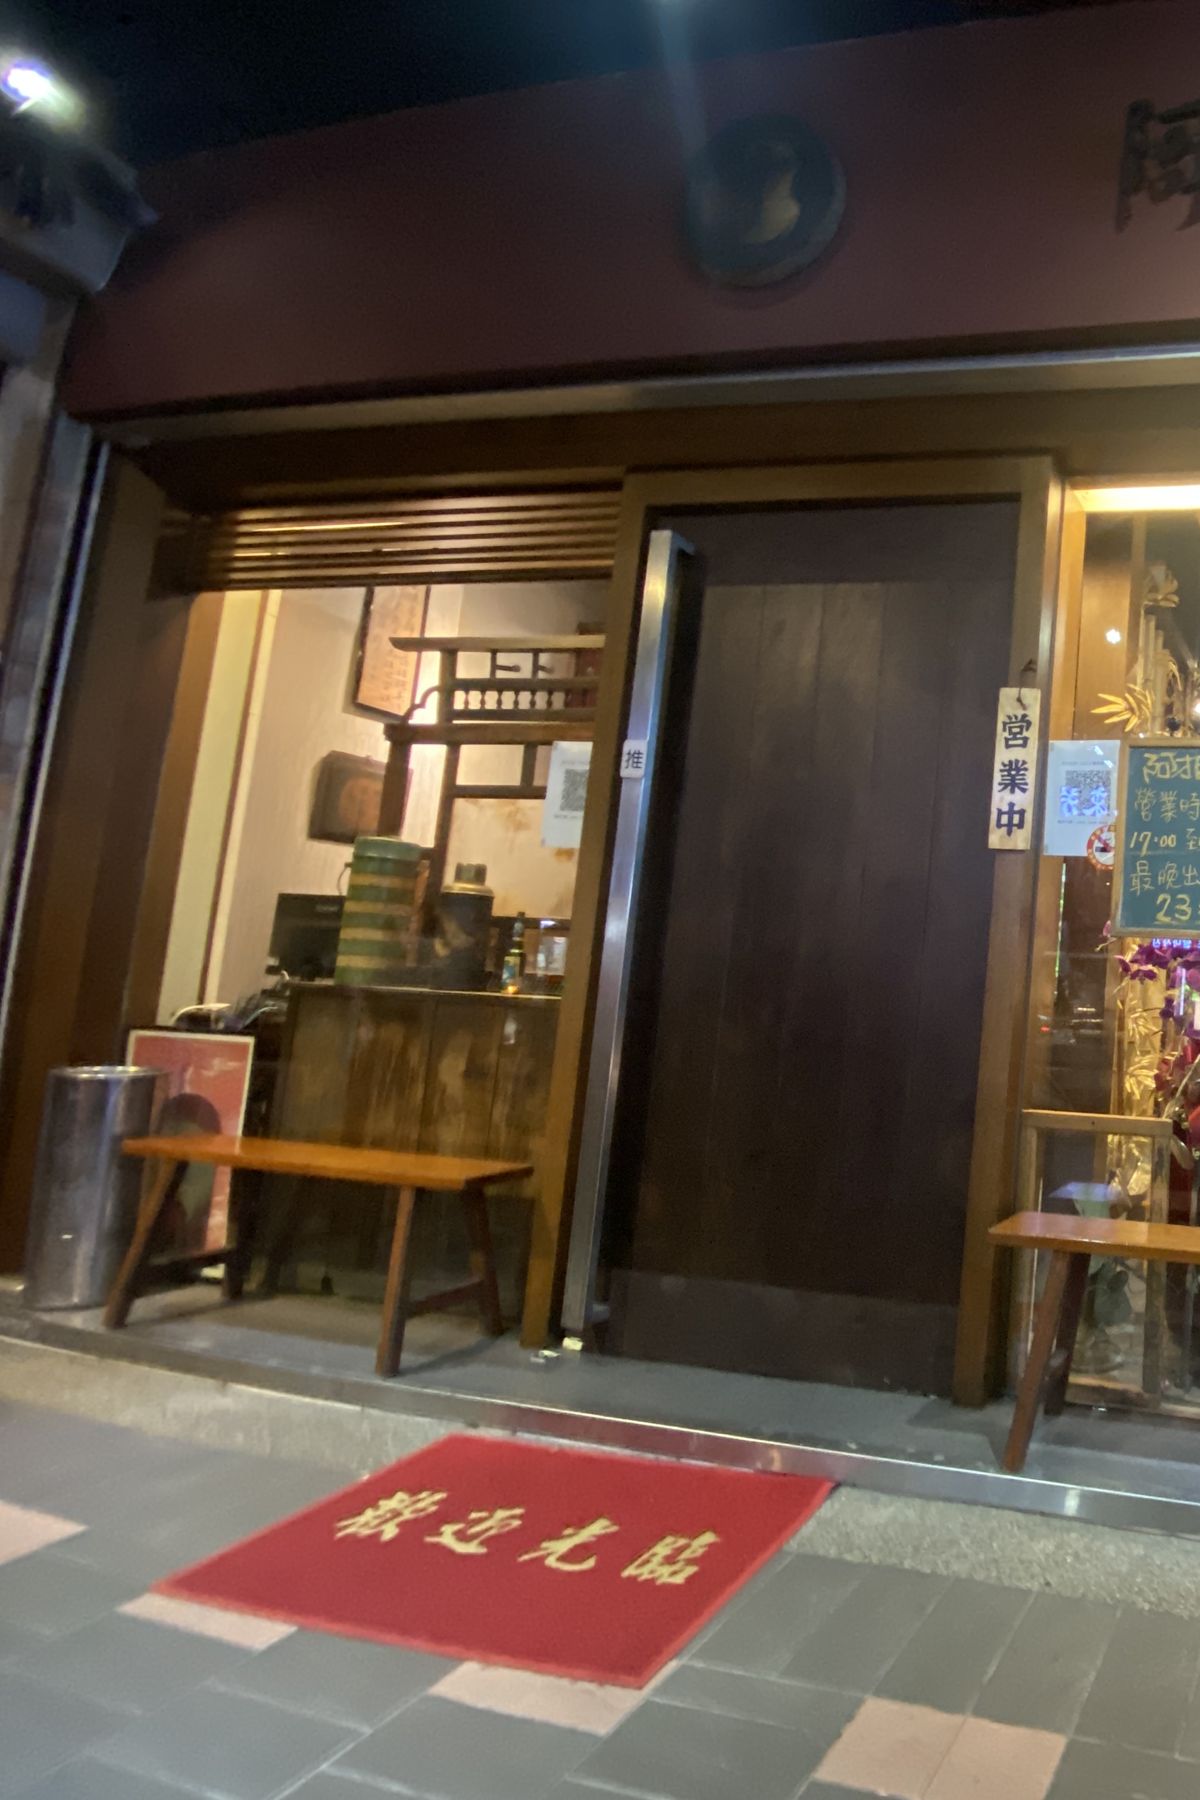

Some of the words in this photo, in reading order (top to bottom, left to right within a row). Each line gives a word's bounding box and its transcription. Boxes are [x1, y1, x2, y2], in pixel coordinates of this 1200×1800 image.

[625, 749, 644, 769] 推
[1130, 831, 1177, 856] 17:00
[335, 1490, 721, 1585] 歡迎光臨
